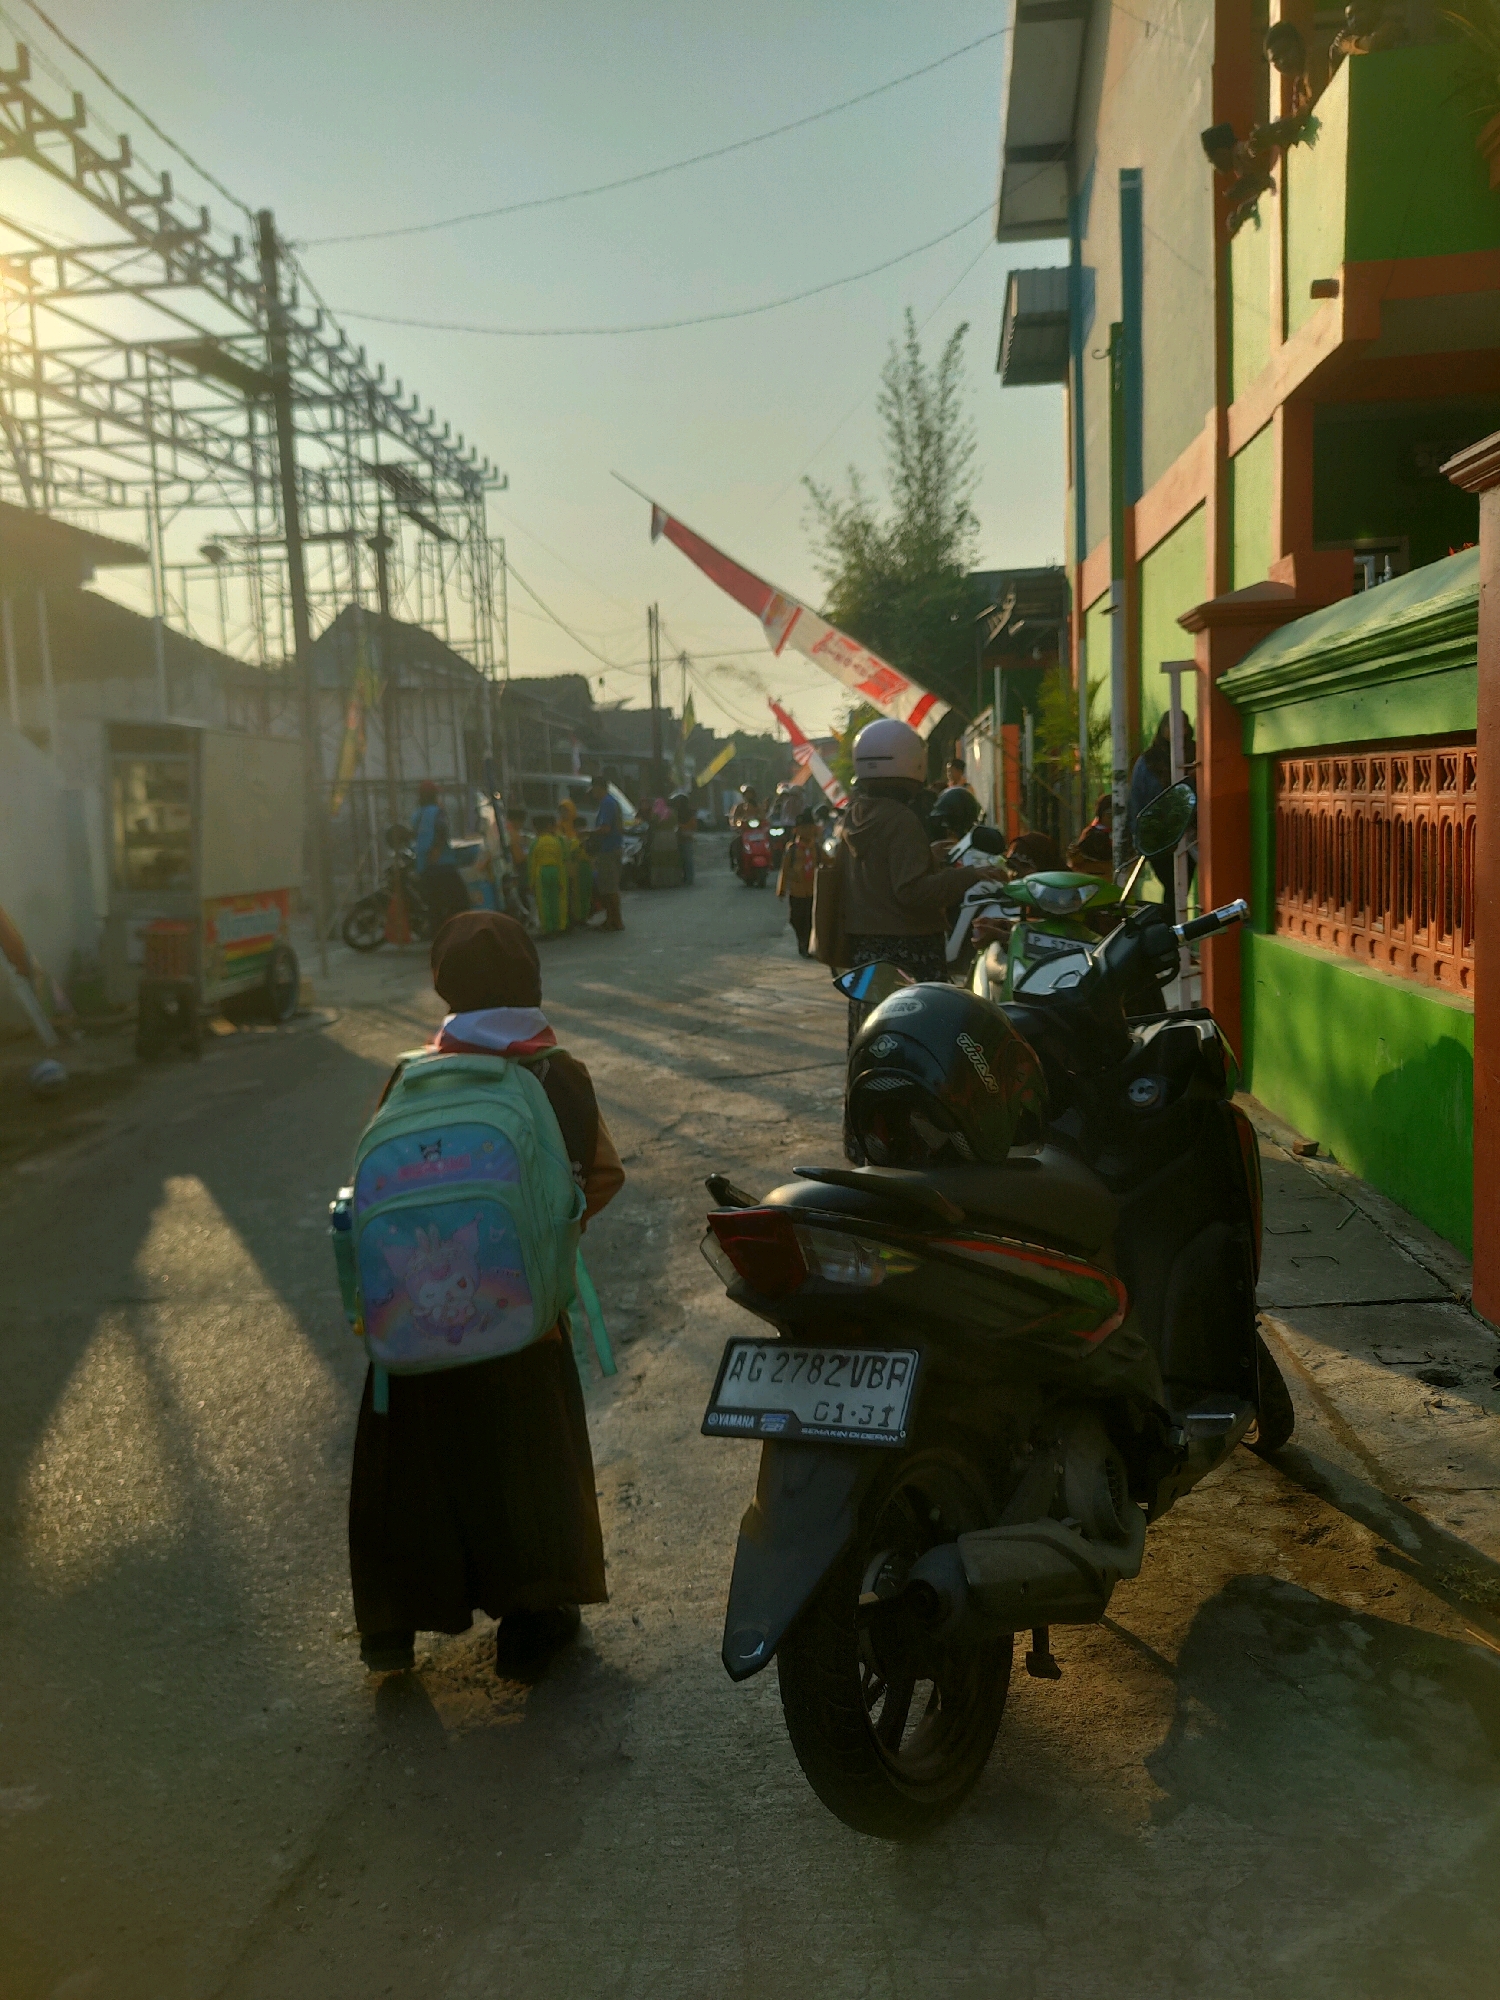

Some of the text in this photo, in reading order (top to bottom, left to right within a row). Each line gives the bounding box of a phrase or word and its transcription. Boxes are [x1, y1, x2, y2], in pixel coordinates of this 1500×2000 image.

[728, 1351, 767, 1382] AG
[771, 1351, 851, 1388] 2782
[718, 1413, 755, 1428] YAMAHA
[801, 1427, 898, 1442] SEMAKIN DI DEPAN
